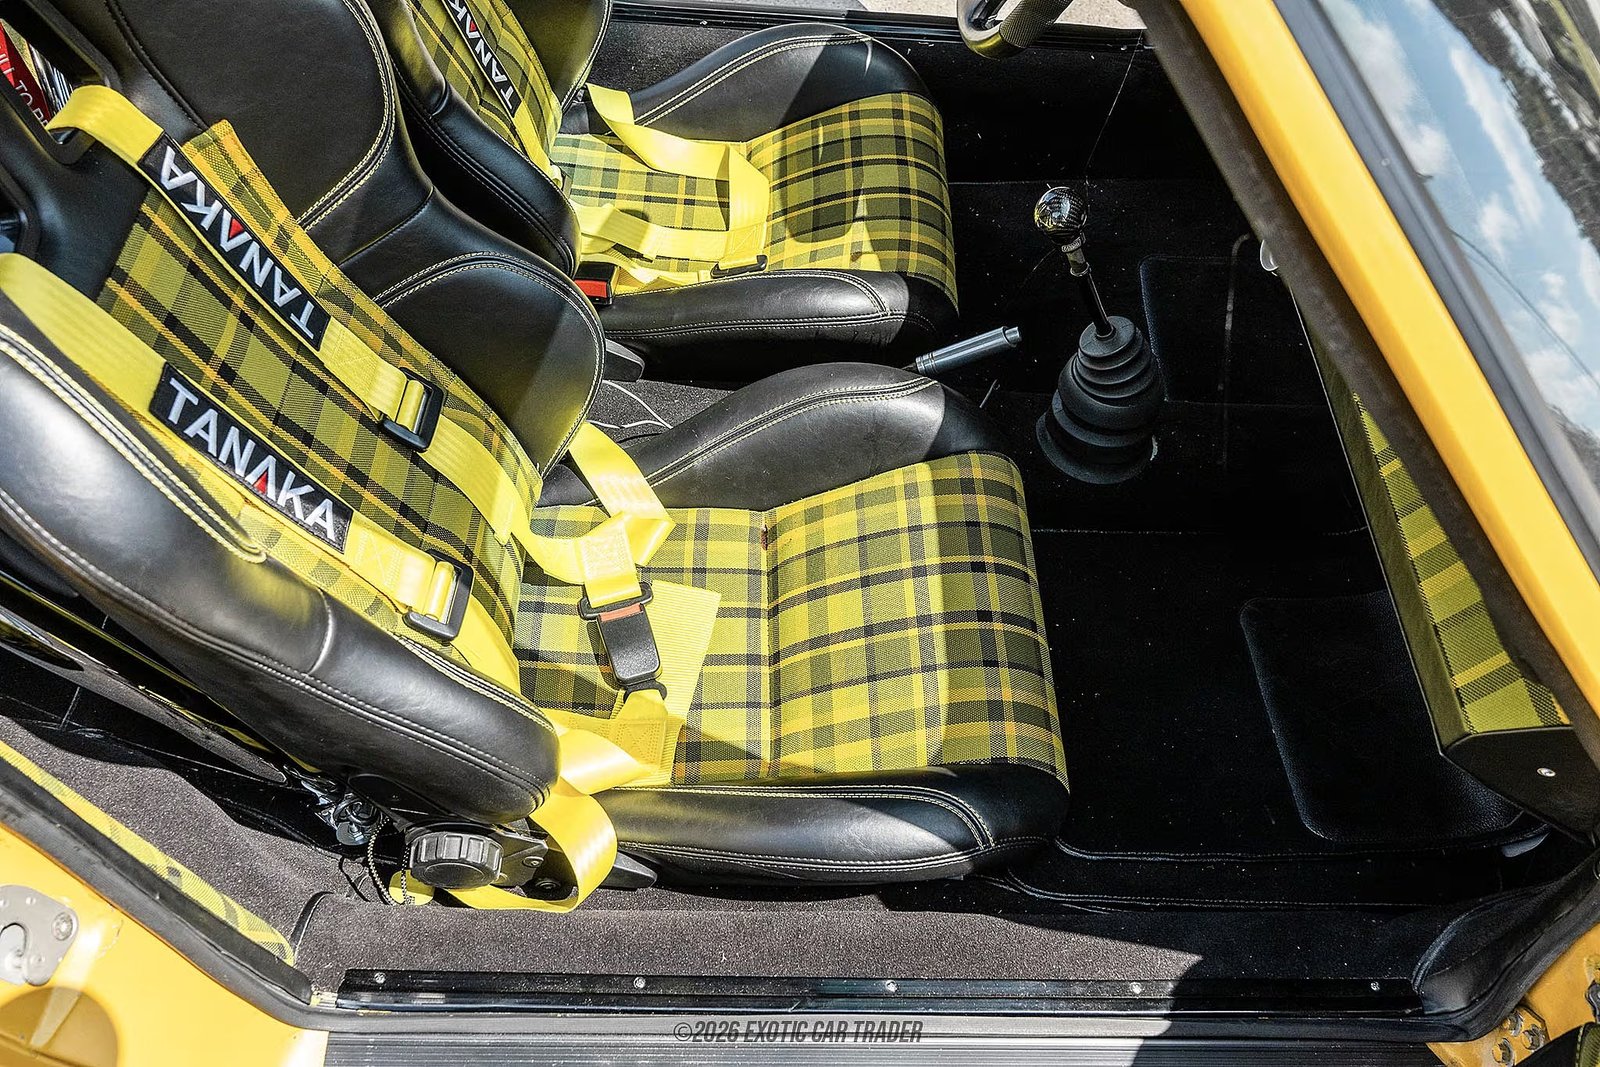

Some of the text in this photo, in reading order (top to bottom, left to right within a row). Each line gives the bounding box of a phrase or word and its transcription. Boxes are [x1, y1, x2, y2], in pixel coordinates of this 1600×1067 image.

[448, 0, 514, 110] TANAK
[160, 145, 315, 340] TANAKA
[168, 377, 336, 542] TANAKA
